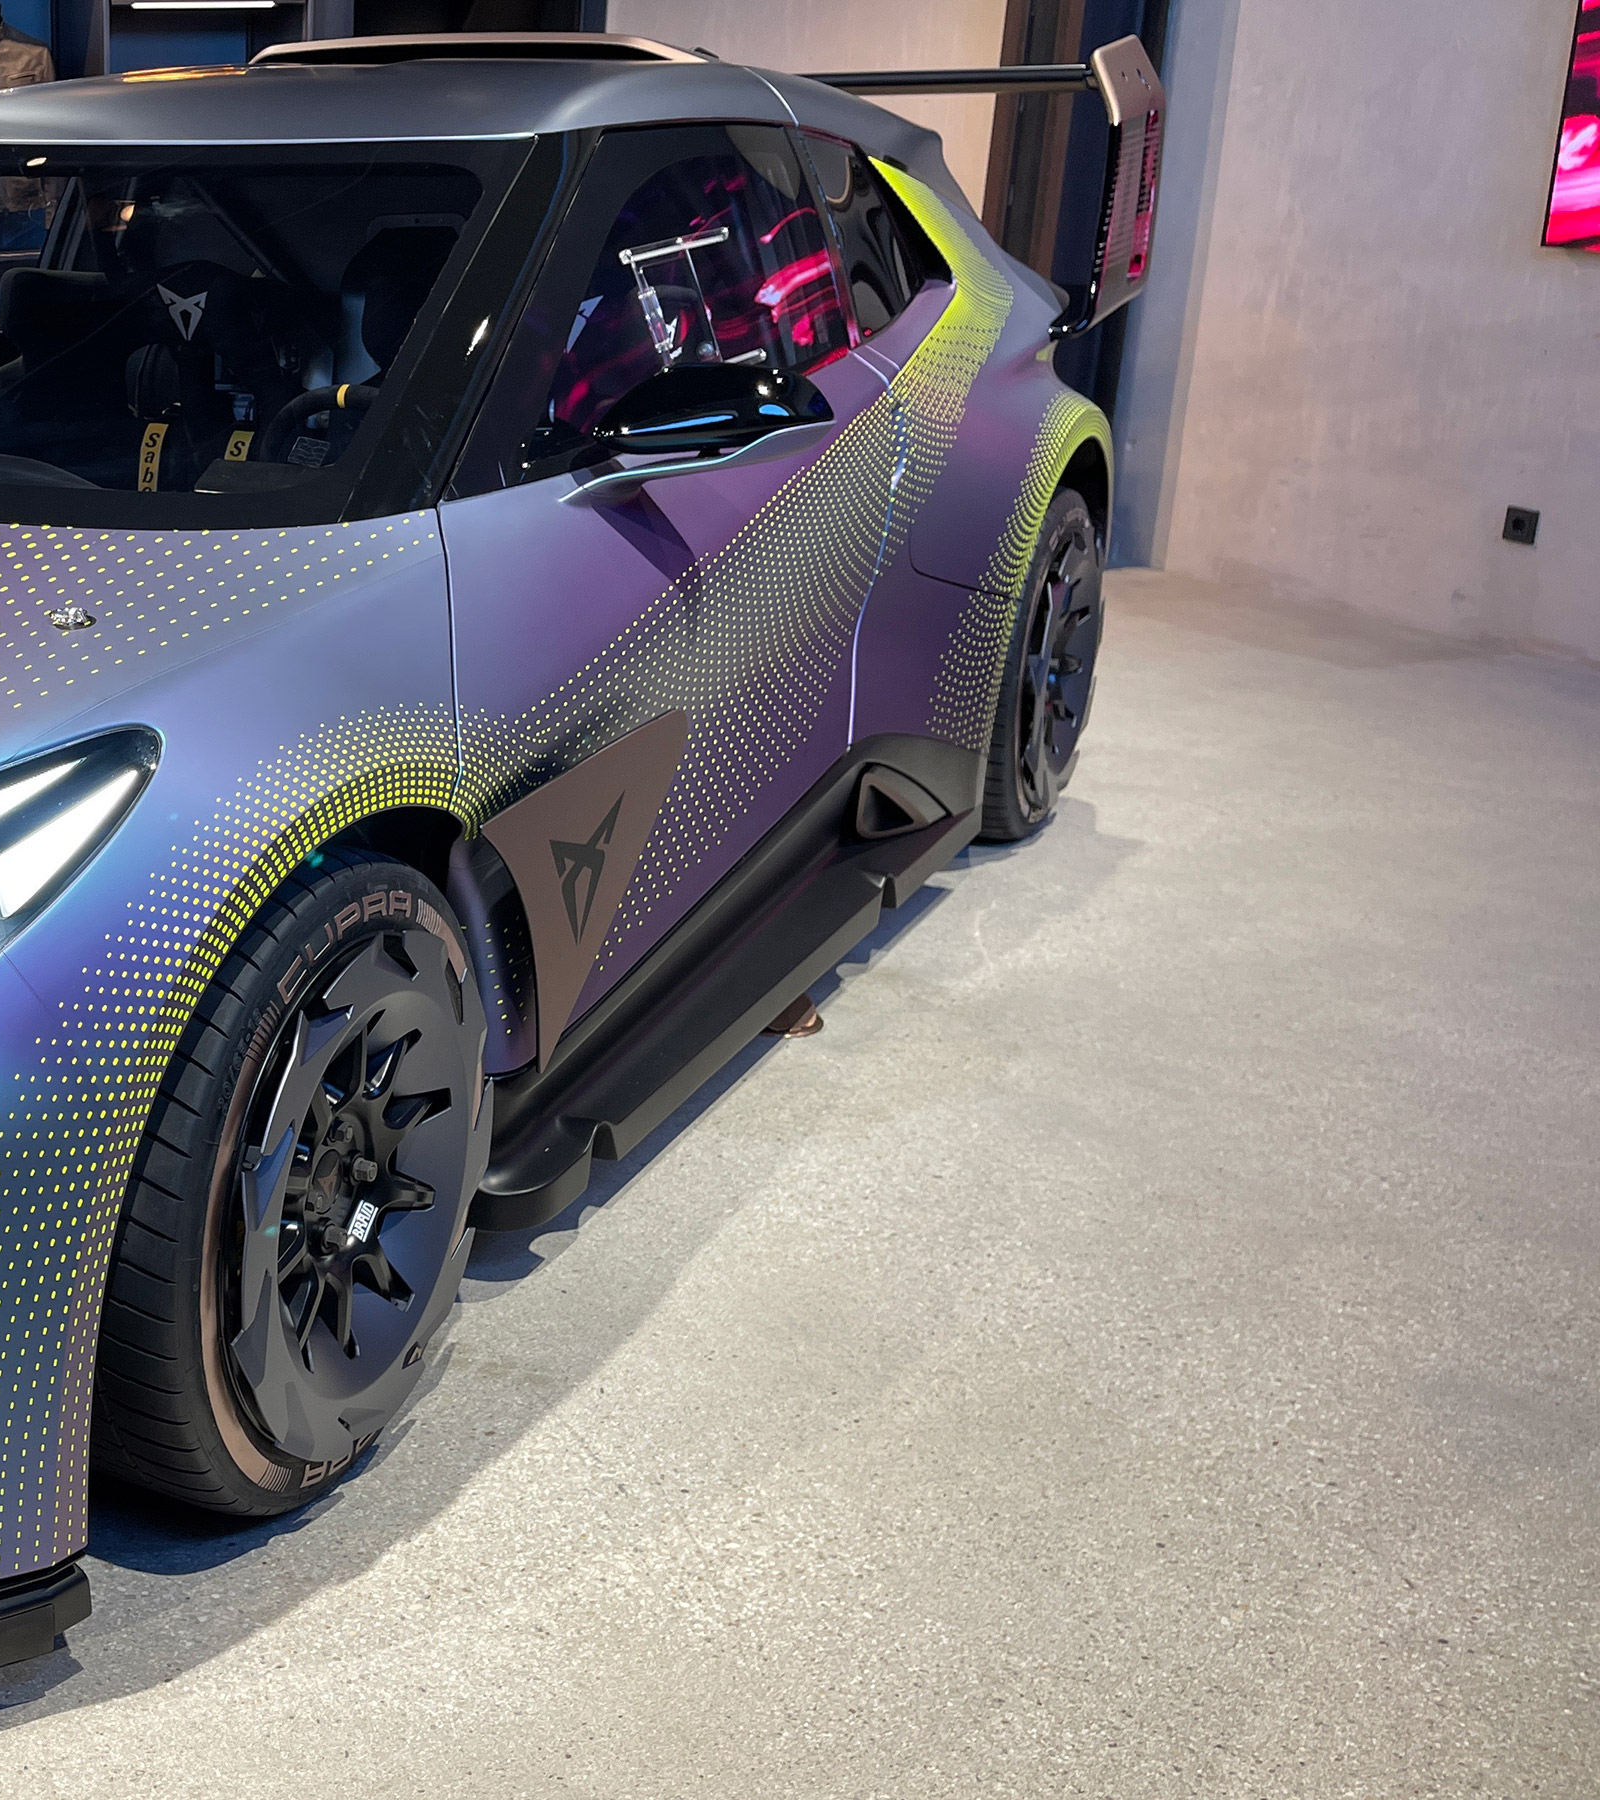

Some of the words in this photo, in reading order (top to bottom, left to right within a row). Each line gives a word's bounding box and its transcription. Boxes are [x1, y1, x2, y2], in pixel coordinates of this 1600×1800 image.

[277, 890, 412, 1005] CUPRA
[352, 1202, 375, 1241] BRAID
[300, 1432, 374, 1488] PRA
